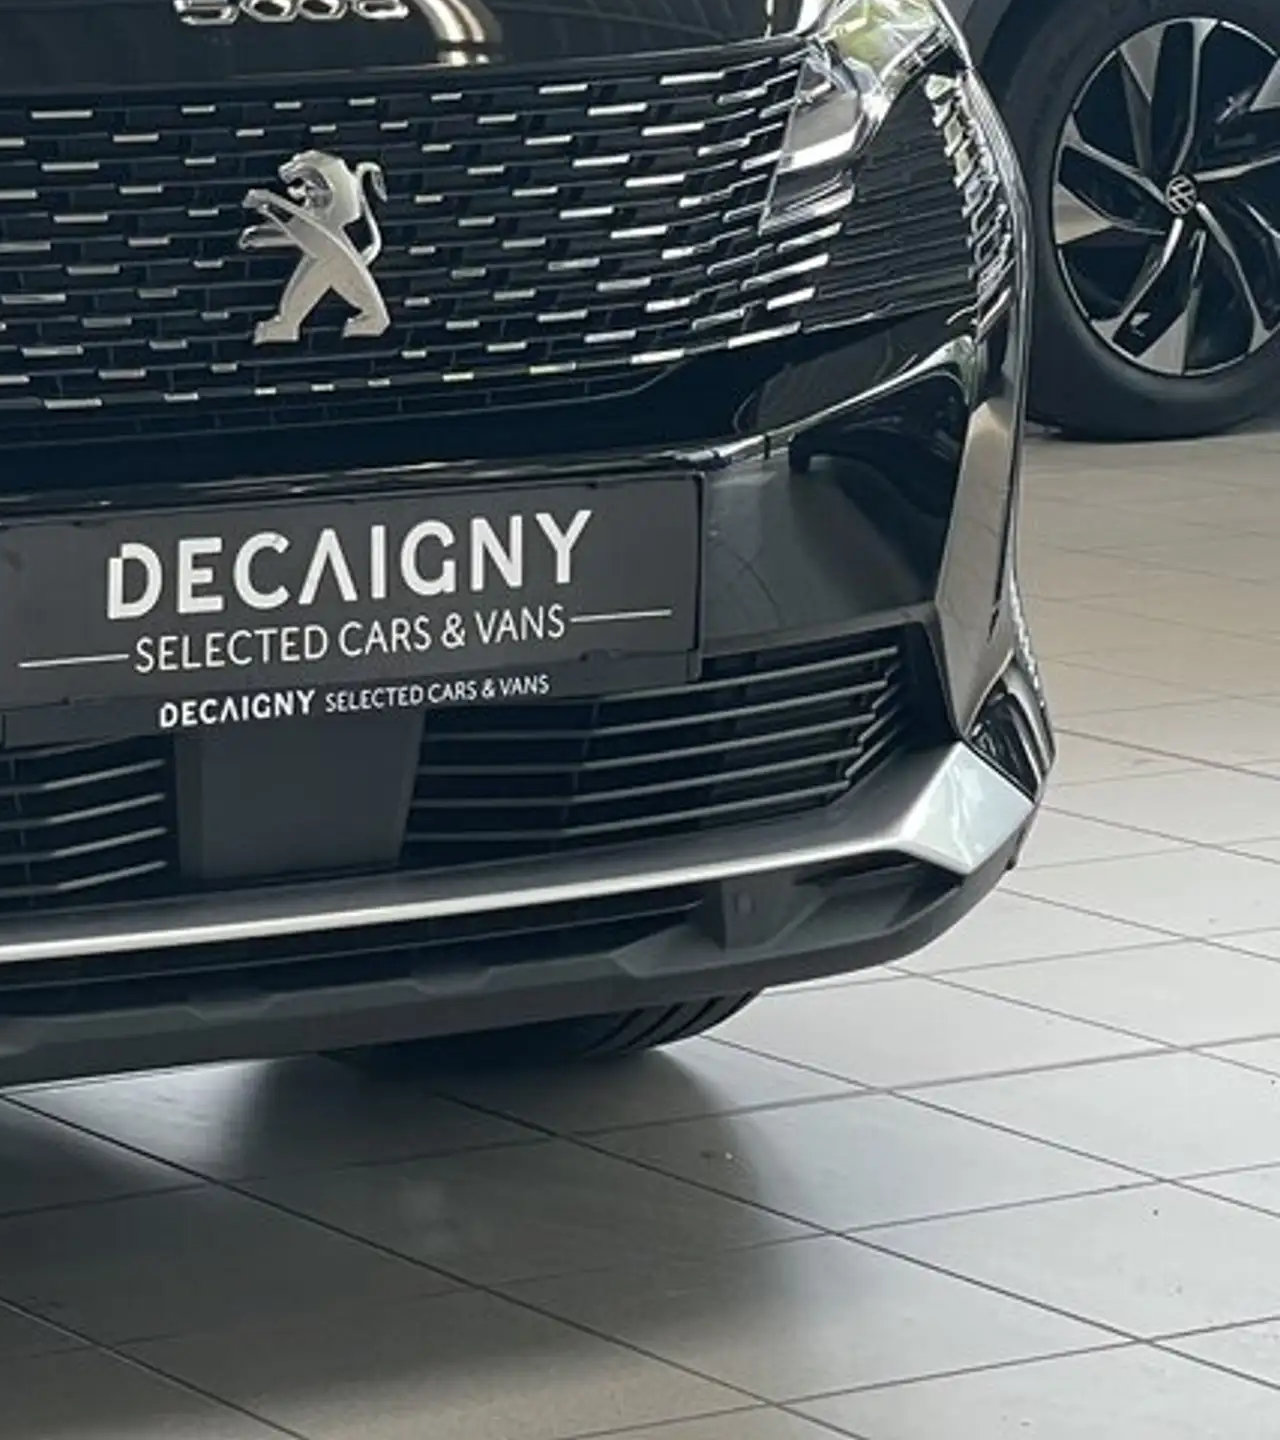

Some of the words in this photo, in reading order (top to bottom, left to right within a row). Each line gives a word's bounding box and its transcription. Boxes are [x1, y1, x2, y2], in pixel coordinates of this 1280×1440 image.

[106, 509, 593, 621] DECAIGNY
[134, 624, 329, 673] SELECTED
[338, 614, 433, 657] CARS
[440, 612, 467, 650] &
[474, 602, 566, 645] VANS
[158, 688, 316, 729] DECAIGNY
[324, 684, 424, 714] SELECTED
[427, 679, 479, 704] CARS
[481, 677, 495, 699] &
[498, 673, 550, 697] VANS
